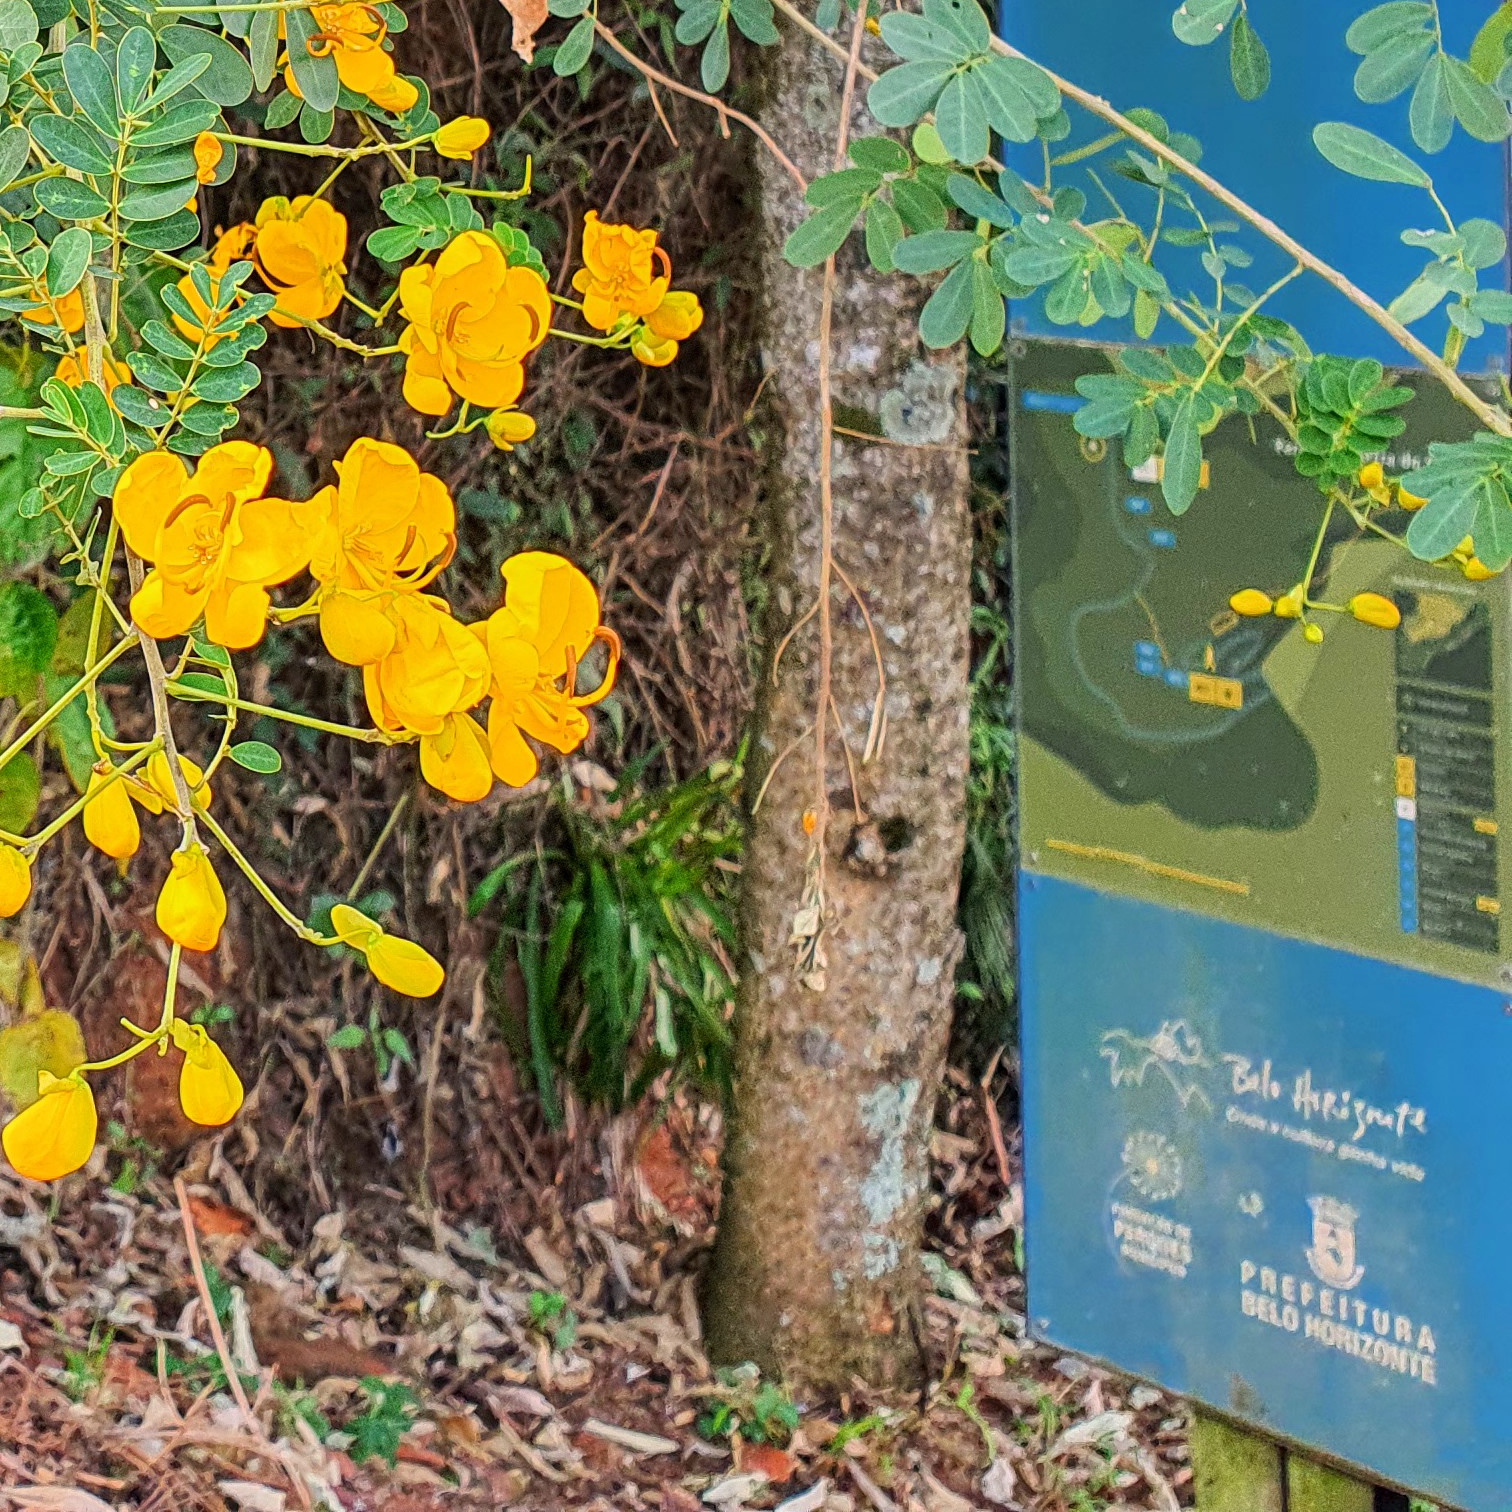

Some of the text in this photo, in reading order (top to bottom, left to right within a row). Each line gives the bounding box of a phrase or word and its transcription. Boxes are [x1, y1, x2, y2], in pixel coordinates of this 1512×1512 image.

[1240, 1259, 1437, 1354] PREFEITURA
[1241, 1289, 1437, 1386] BELO HORIZONTE
